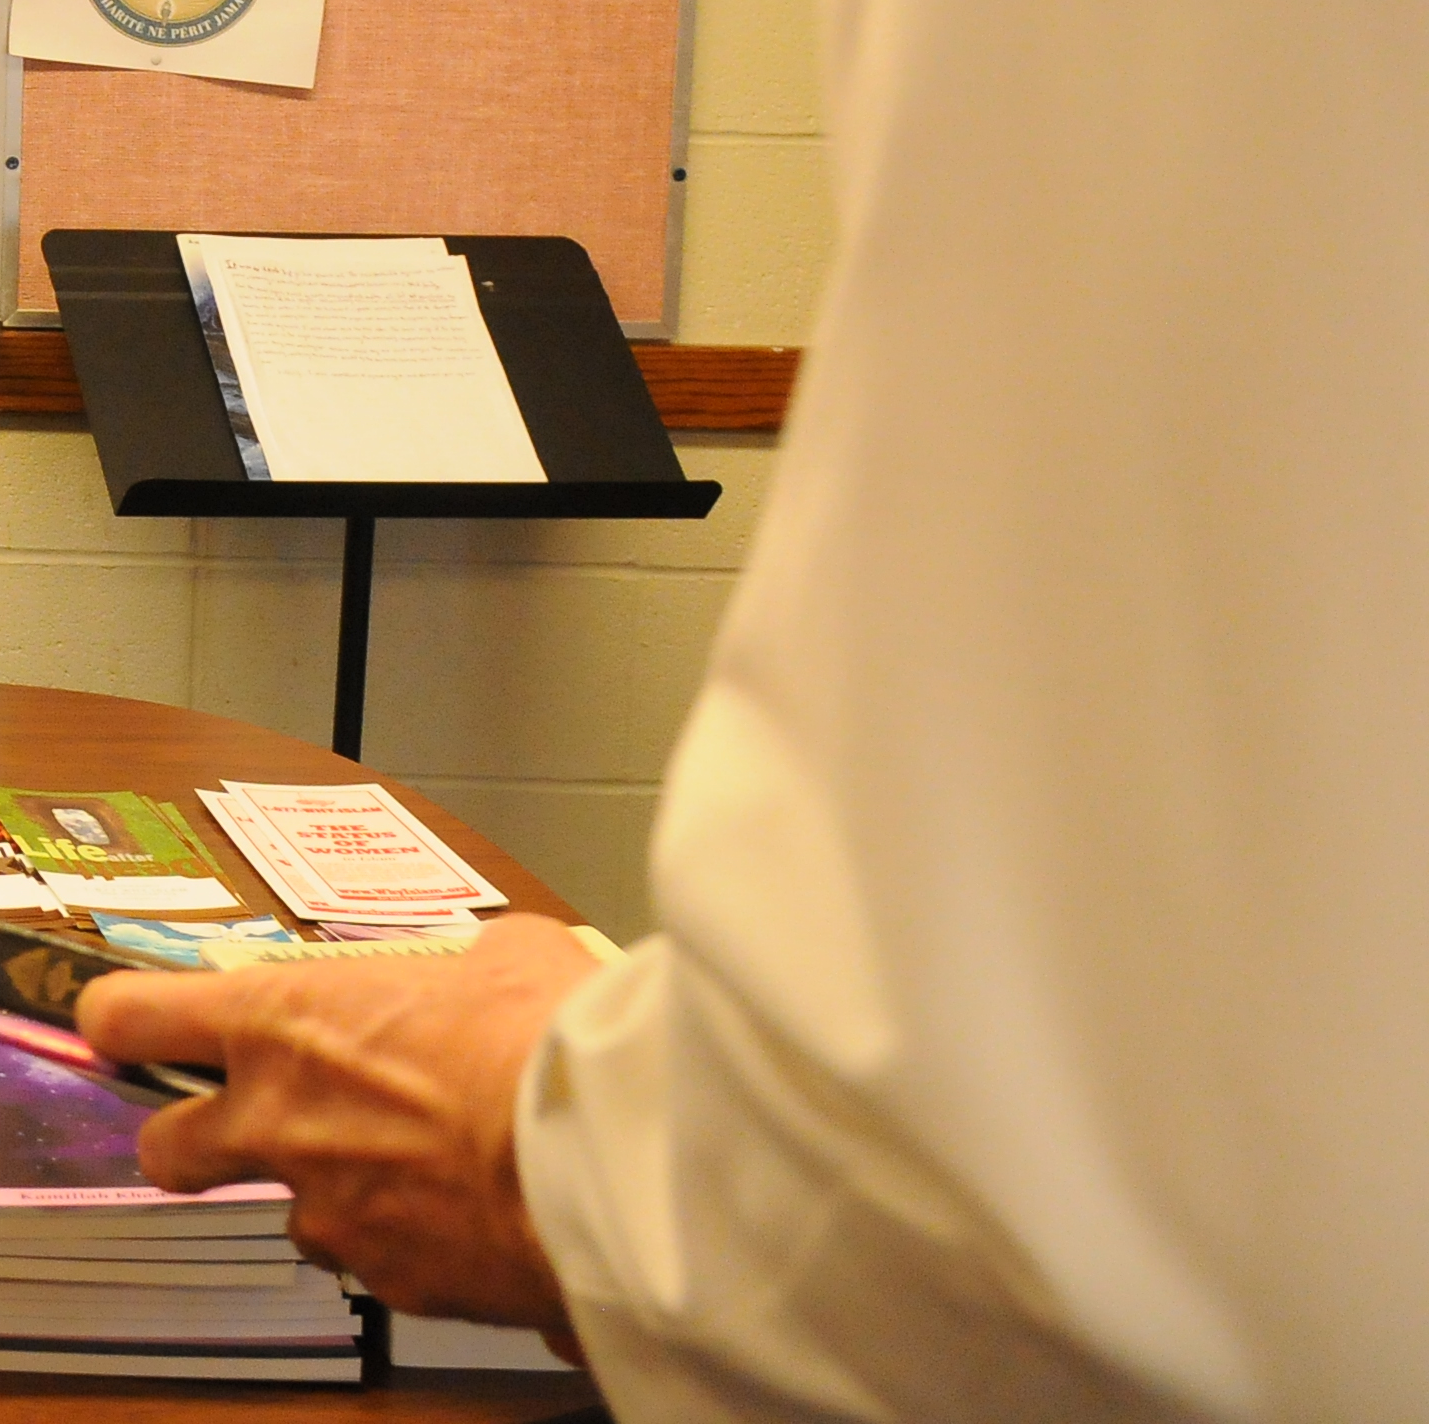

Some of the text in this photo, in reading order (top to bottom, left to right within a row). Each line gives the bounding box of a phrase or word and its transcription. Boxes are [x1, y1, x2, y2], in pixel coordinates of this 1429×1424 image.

[147, 25, 167, 39] NE
[296, 831, 397, 839] STATUS
[11, 833, 109, 862] Life
[304, 846, 421, 855] WOMEN
